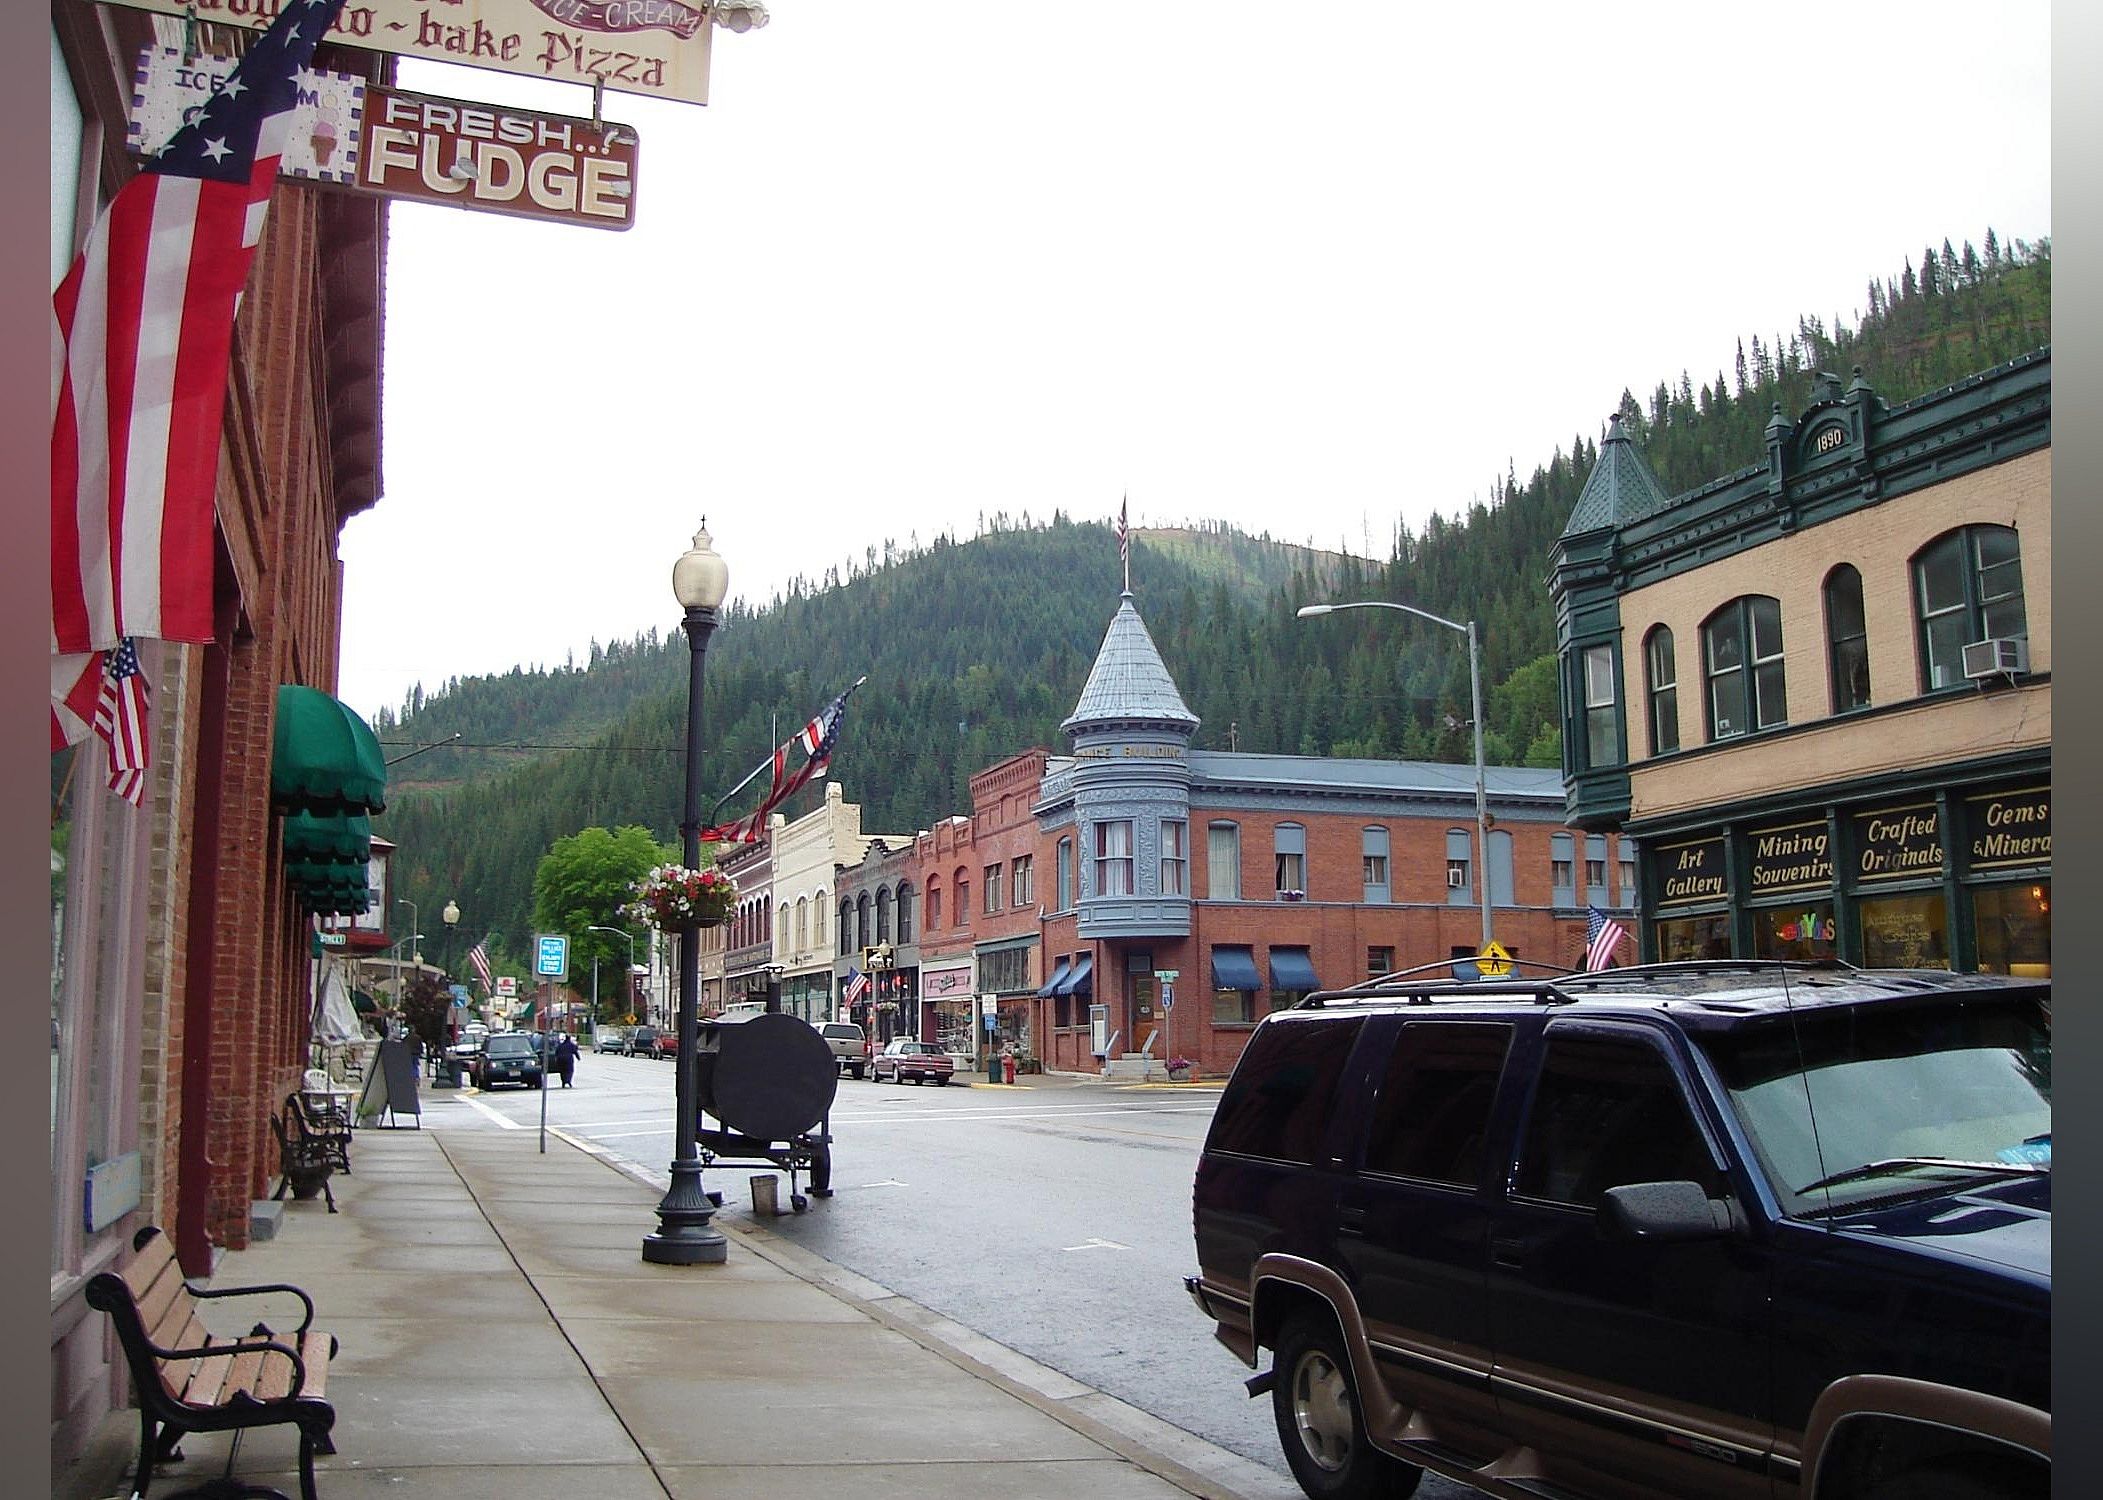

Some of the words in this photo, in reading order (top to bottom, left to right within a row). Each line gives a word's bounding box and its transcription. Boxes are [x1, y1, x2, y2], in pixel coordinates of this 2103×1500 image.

[412, 9, 521, 61] bake
[536, 31, 668, 87] Pizza
[175, 69, 227, 93] ICE
[367, 125, 631, 218] FUDGE
[1817, 429, 1842, 453] 1890
[1986, 802, 2048, 827] Gems
[1868, 813, 1937, 846] Crafted
[1757, 833, 1828, 858] Mining
[1861, 843, 1943, 872] Originals
[1677, 849, 1705, 870] Art
[1666, 876, 1722, 897] Gallery
